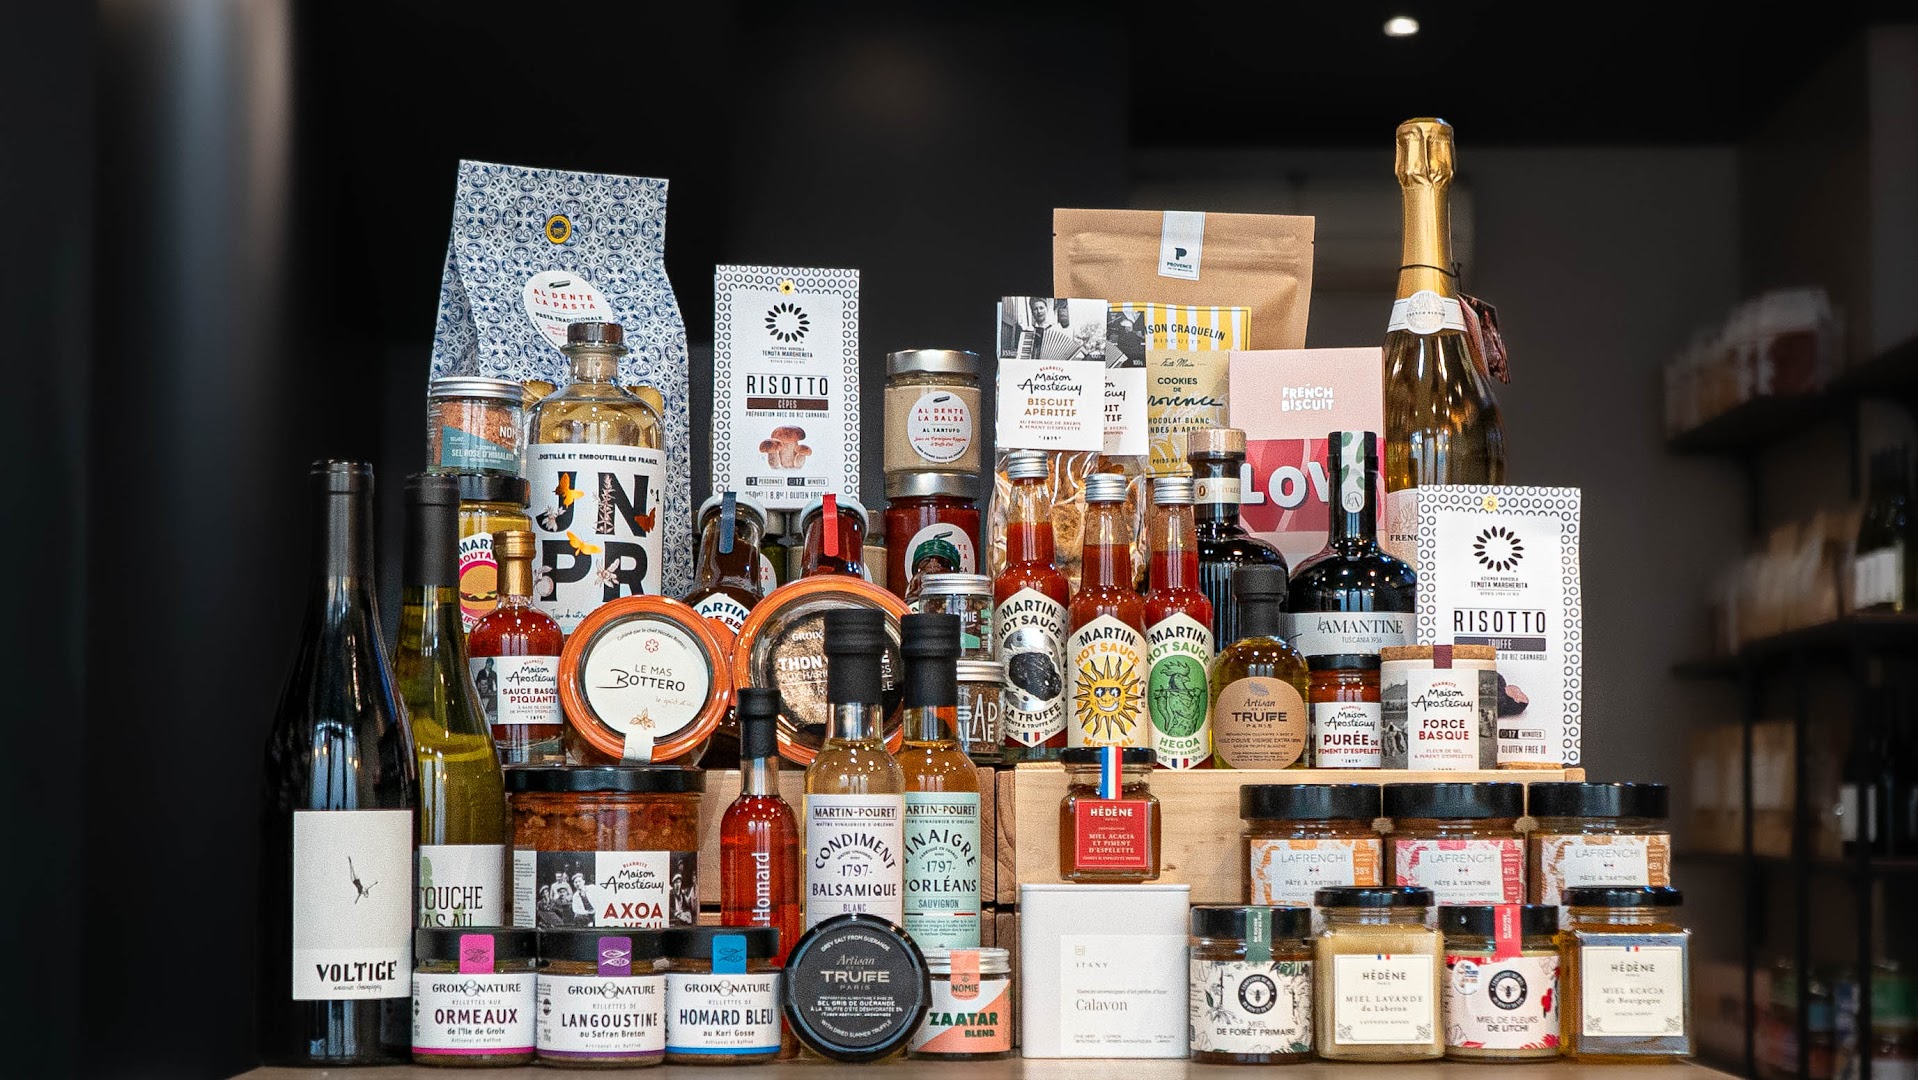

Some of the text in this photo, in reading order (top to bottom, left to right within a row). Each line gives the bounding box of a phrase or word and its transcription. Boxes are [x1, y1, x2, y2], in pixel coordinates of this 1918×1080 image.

[1167, 262, 1192, 270] PROVENCE
[534, 288, 594, 302] AL DENTE
[536, 298, 596, 310] LA PASTA
[536, 312, 603, 323] PASTA TRADIZIONALE
[1172, 324, 1226, 341] CRAQUELIN
[1034, 372, 1072, 382] Maison
[1157, 377, 1198, 385] COOKIES
[746, 375, 828, 396] RISOTTO
[1282, 386, 1334, 399] FRENCH
[1028, 398, 1075, 406] BISCUIT
[1148, 396, 1223, 406] rovence
[1281, 398, 1334, 412] BISCUIT
[1024, 406, 1078, 417] APÉRITIF
[579, 453, 626, 462] EMBOUTEILLÉ
[790, 492, 809, 500] GLUTEN
[697, 602, 748, 621] ARTIN
[1002, 600, 1058, 619] MARTIN
[998, 614, 1062, 640] HOT SAUCE
[1454, 610, 1546, 632] RISOTTO
[1079, 626, 1136, 646] MARTIN
[1150, 626, 1208, 646] MARTIN
[1075, 642, 1140, 667] HOT SAUCE
[1147, 642, 1210, 666] HOT SAUCE
[520, 665, 550, 674] Maison
[778, 655, 822, 672] THON
[634, 664, 672, 677] LE MAS
[598, 668, 686, 692] BOTTERO
[510, 696, 556, 704] PIQUANTE
[1427, 689, 1464, 698] Maison
[1243, 698, 1276, 708] Artisan
[1018, 702, 1062, 722] TRUFFE
[1232, 712, 1288, 722] TRUFFE
[1337, 712, 1367, 720] Maison
[1423, 720, 1466, 730] FORCE
[1324, 731, 1369, 746] PURÉE
[1418, 730, 1470, 741] BASQUE
[1159, 737, 1200, 750] HEGOA
[1502, 745, 1539, 754] GLUTEN FREE
[815, 806, 896, 818] MARTIN-POURET
[1090, 806, 1133, 817] HÉDÈNE
[815, 832, 897, 869] CONDIMENT
[905, 829, 977, 868] INAIGRE
[618, 870, 655, 879] Maison
[752, 852, 770, 922] Homard
[812, 882, 897, 897] BALSAMIQUE
[843, 904, 867, 912] BLANC
[918, 899, 959, 908] SAUVIGNON
[604, 902, 664, 919] AXOA
[820, 942, 834, 952] GREY
[834, 936, 847, 946] SALT
[836, 954, 875, 966] Artisan
[316, 960, 397, 982] VOLTIGE
[1611, 962, 1656, 972] HÉDÈNE
[820, 970, 890, 983] TRUFFE
[1362, 970, 1407, 980] HÉDÈNE
[952, 984, 979, 992] NOMIE
[1076, 998, 1128, 1012] Calavon
[435, 1008, 518, 1024] ORMEAUX
[562, 1012, 658, 1028] LANGOUSTINE
[680, 1008, 774, 1025] HOMARD BLEU
[930, 1012, 998, 1026] ZAATAR
[820, 1020, 834, 1030] WITH
[833, 1026, 848, 1036] DRIED
[870, 1020, 892, 1034] TRUFFLE
[1229, 1027, 1257, 1036] FORÊT
